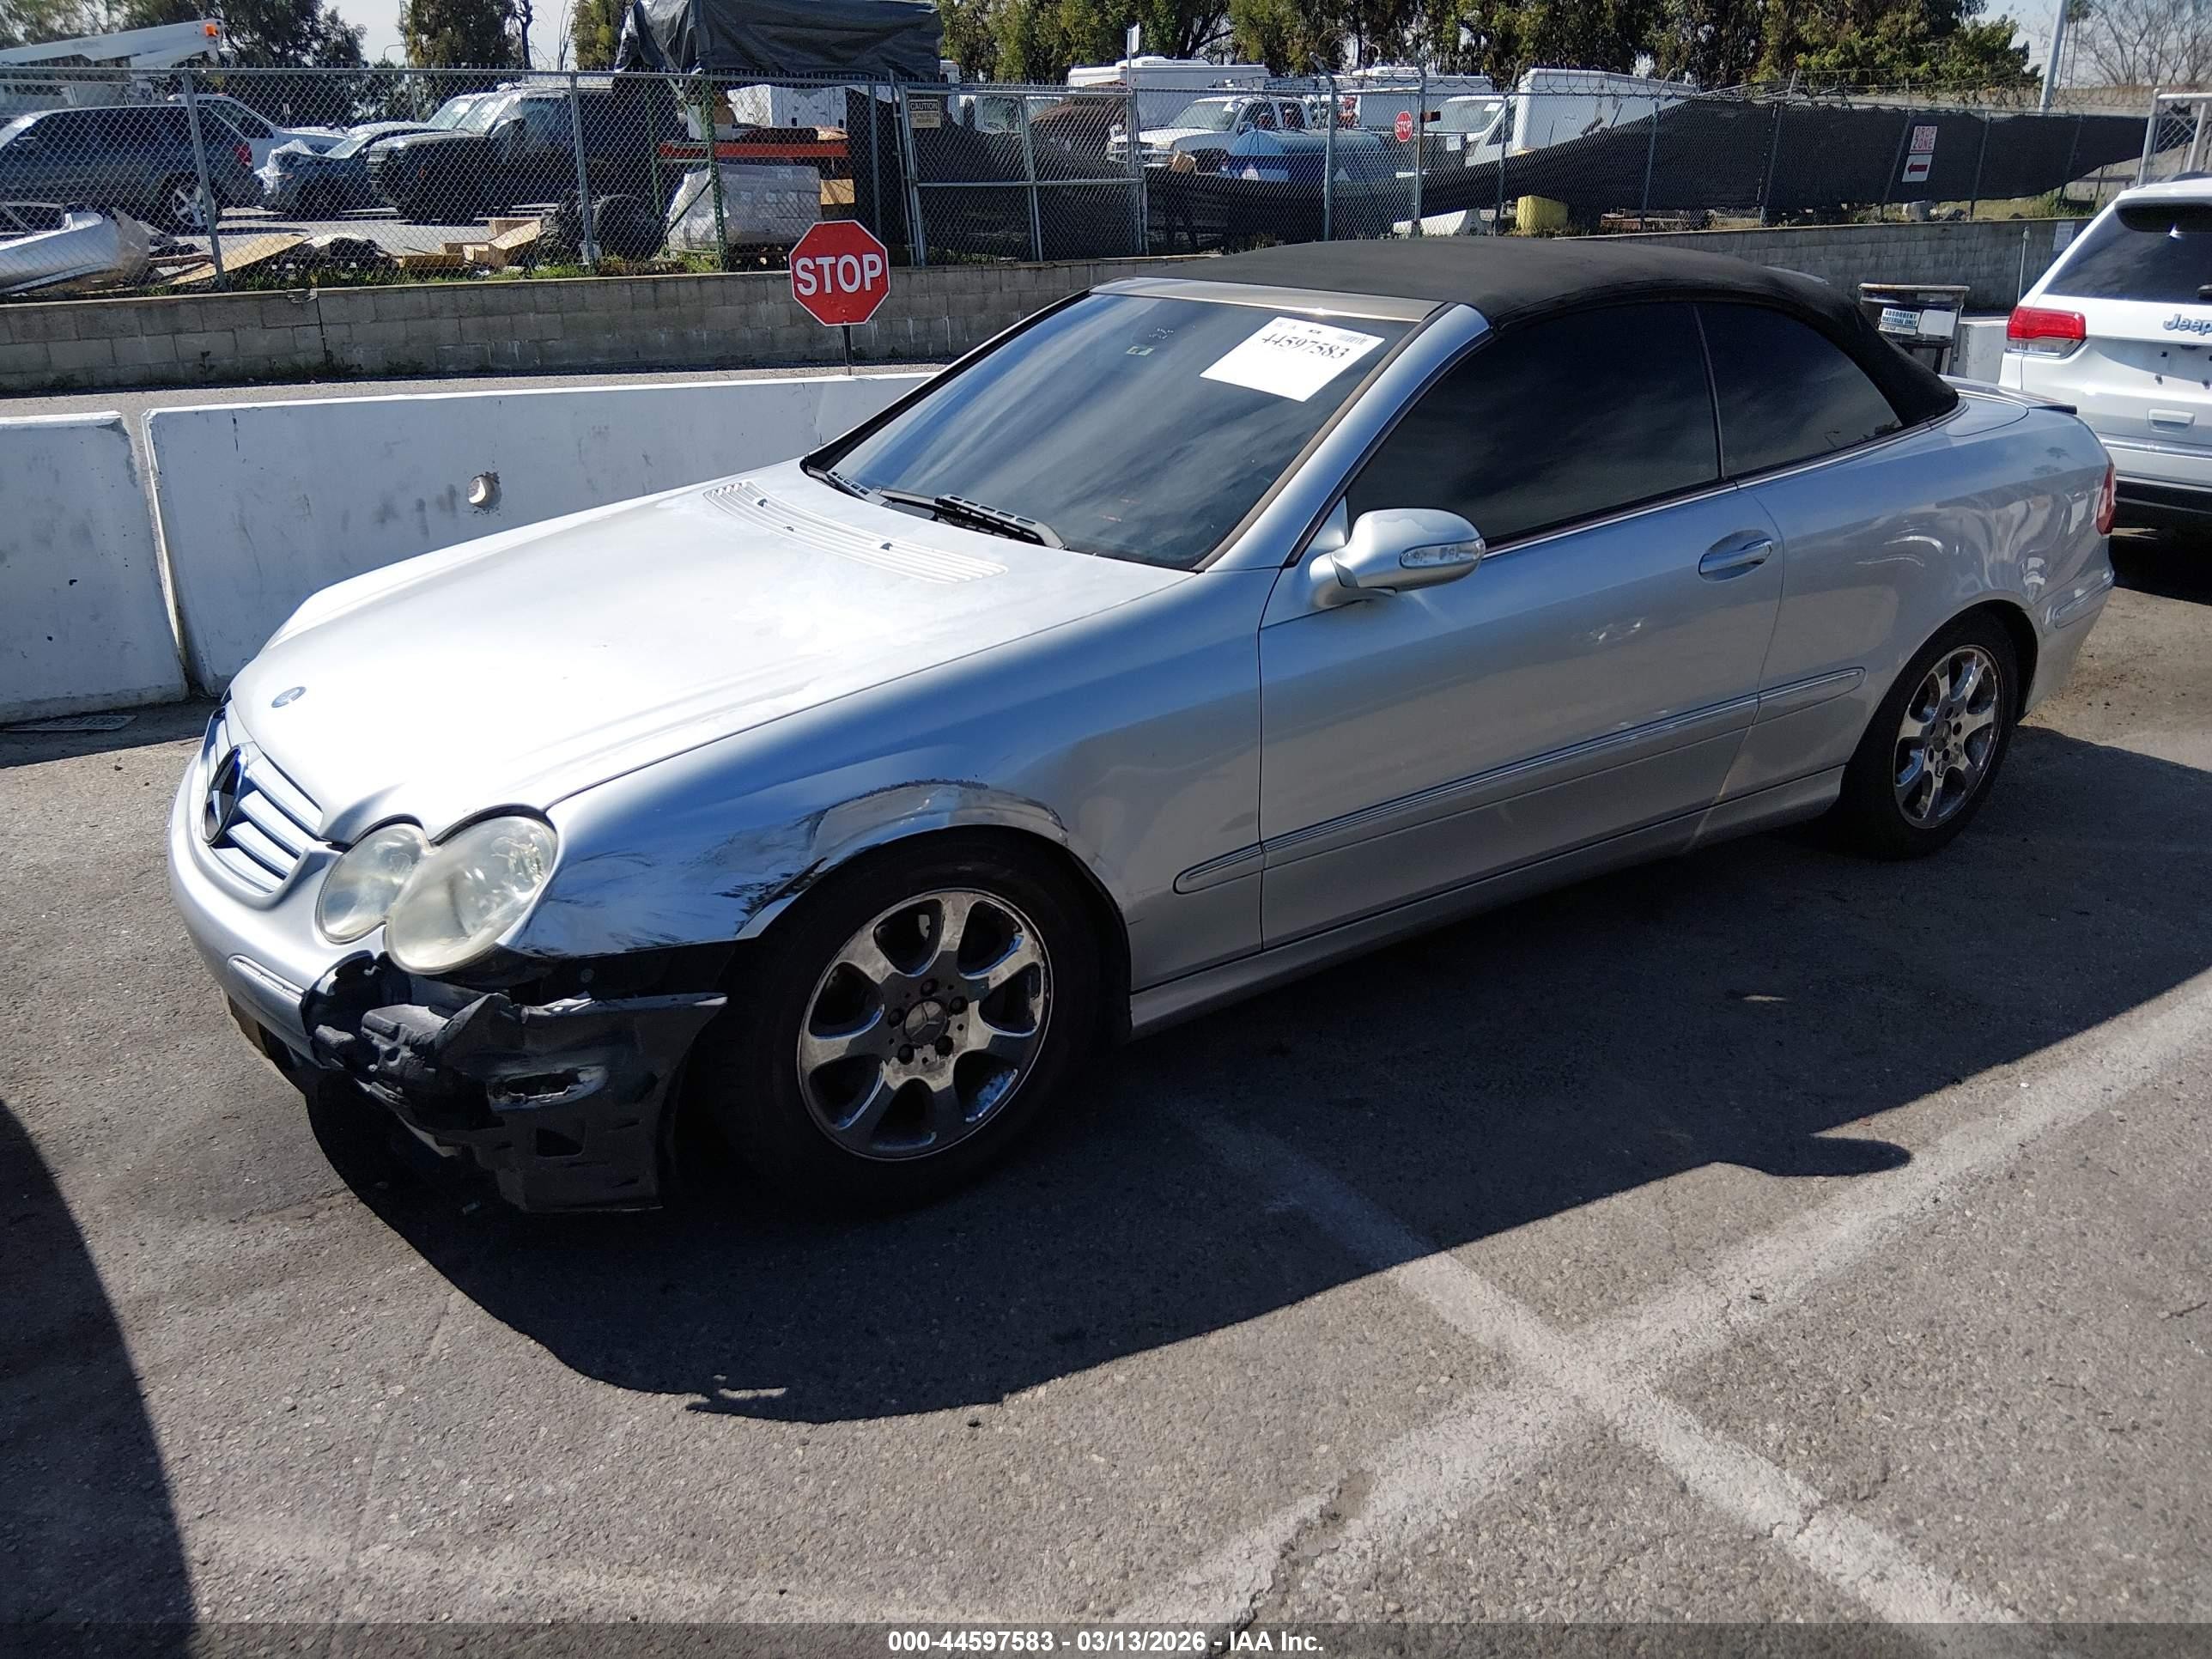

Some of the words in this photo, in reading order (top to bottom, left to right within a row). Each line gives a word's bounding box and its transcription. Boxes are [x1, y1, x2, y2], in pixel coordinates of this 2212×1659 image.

[910, 102, 938, 111] CAUTION
[1396, 120, 1412, 132] STOP
[1916, 127, 1936, 137] DROP
[1913, 137, 1934, 149] ZONE
[795, 253, 883, 296] STOP
[2163, 313, 2212, 336] Jeep
[1262, 333, 1350, 359] 44597583
